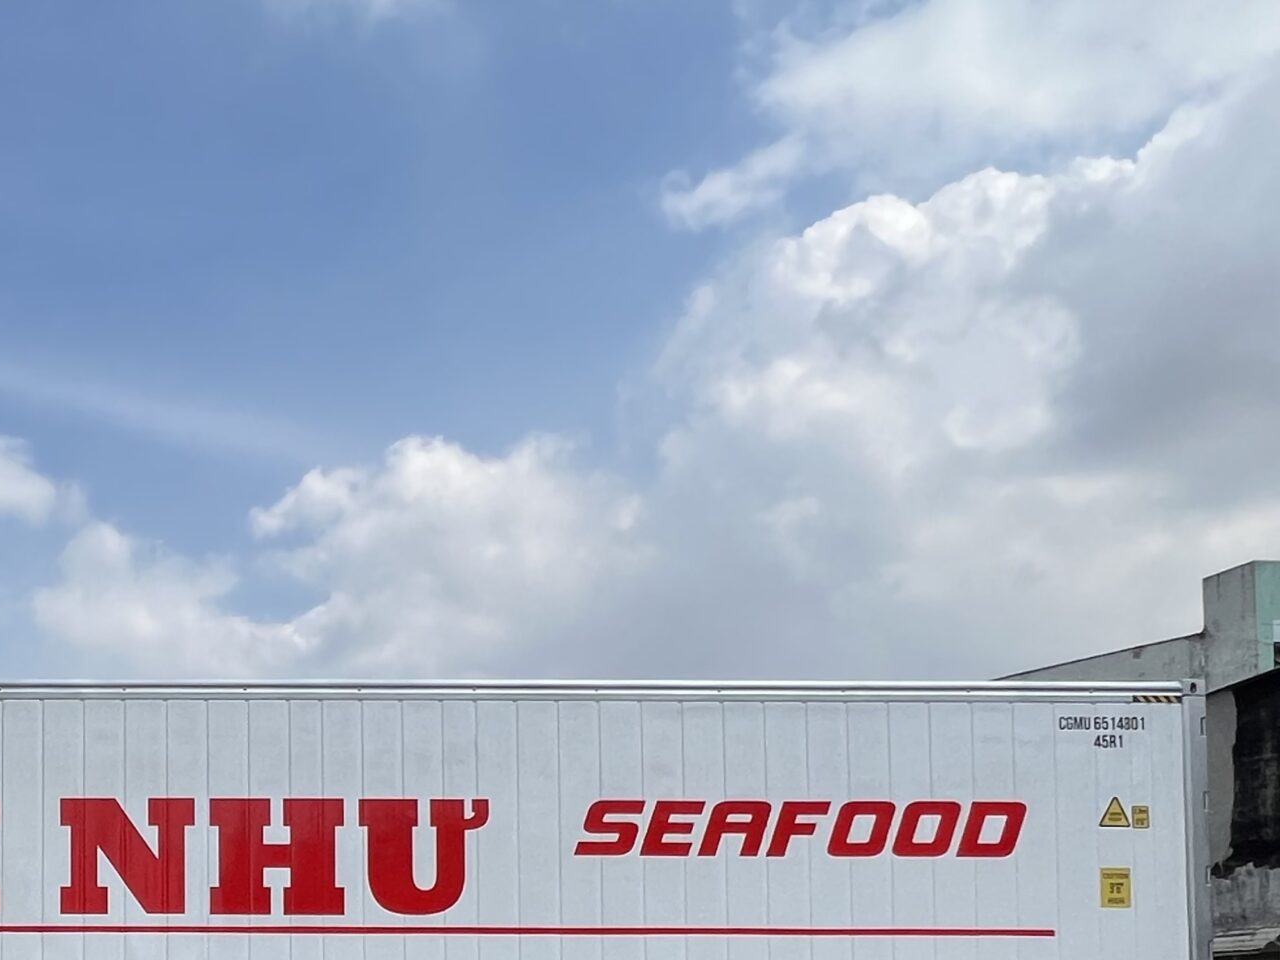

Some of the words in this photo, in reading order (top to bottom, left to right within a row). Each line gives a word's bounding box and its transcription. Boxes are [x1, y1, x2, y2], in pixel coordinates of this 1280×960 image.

[1059, 716, 1091, 730] CGMU
[1093, 734, 1123, 748] 45R1
[59, 796, 490, 916] NHƯ
[574, 799, 1028, 858] SEAFOOD
